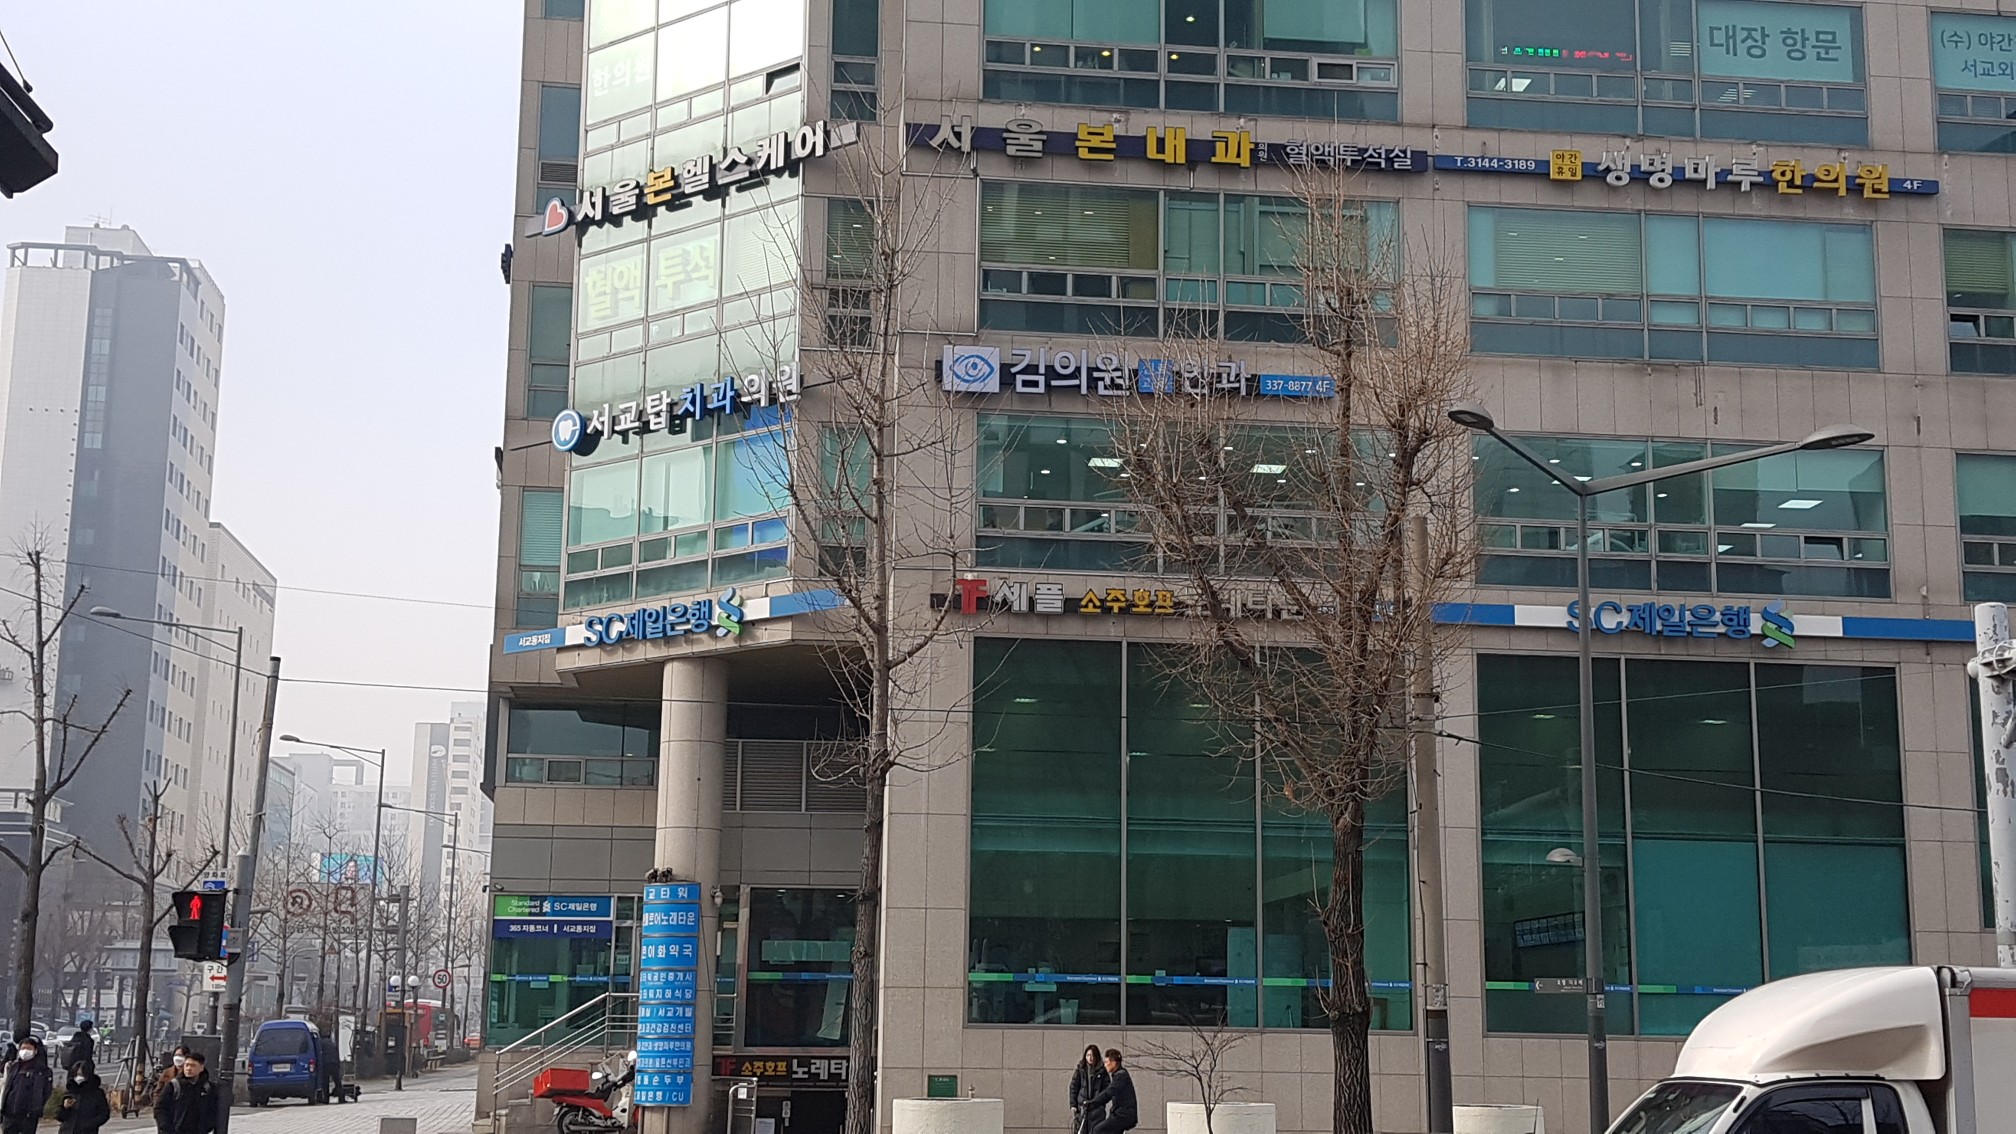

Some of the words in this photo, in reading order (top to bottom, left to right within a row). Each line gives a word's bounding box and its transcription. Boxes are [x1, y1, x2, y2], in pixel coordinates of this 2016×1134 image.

[1709, 24, 1770, 59] 대장
[1780, 27, 1842, 62] 항문
[1941, 29, 1971, 50] (수)
[1978, 31, 2016, 53] 야간
[1961, 59, 2015, 80] 서교외
[1285, 138, 1413, 170] 혈액투석실
[1454, 156, 1536, 170] T.3144-3189
[1555, 153, 1578, 164] 야간
[577, 120, 827, 221] 서울본헬스케어
[1555, 166, 1578, 178] 휴일
[1597, 150, 1890, 199] 생명마루한의원
[1902, 180, 1923, 191] 4F
[584, 258, 642, 319] 혈액
[655, 238, 718, 300] 투석
[1009, 347, 1130, 396] 김의원
[1265, 379, 1312, 392] 337-8877
[584, 598, 713, 647] SC제일은행
[741, 1061, 787, 1076] 소주호프
